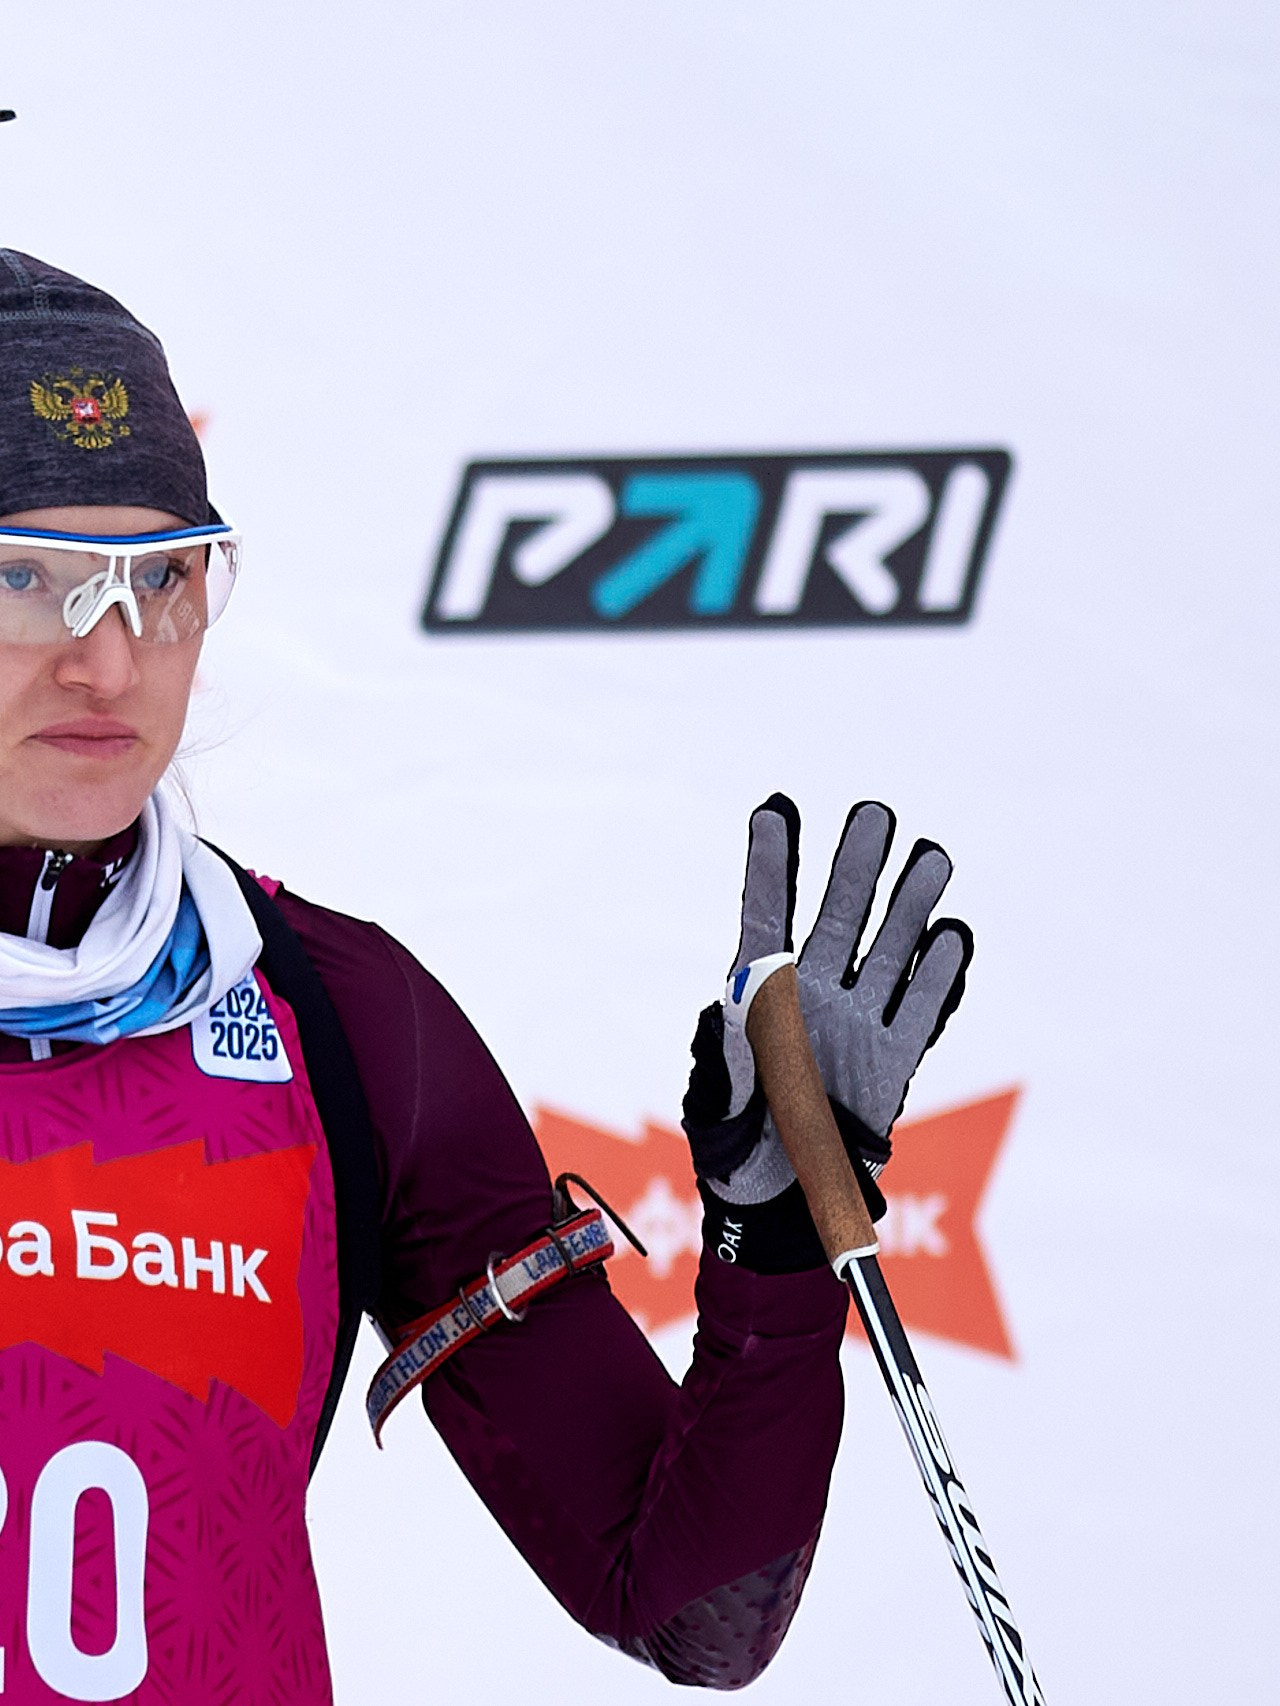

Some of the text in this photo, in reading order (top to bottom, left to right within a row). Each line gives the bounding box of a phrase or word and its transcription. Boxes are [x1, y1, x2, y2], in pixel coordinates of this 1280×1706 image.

[436, 462, 989, 619] PARI
[210, 1020, 278, 1061] 2025
[71, 1209, 272, 1304] Банк
